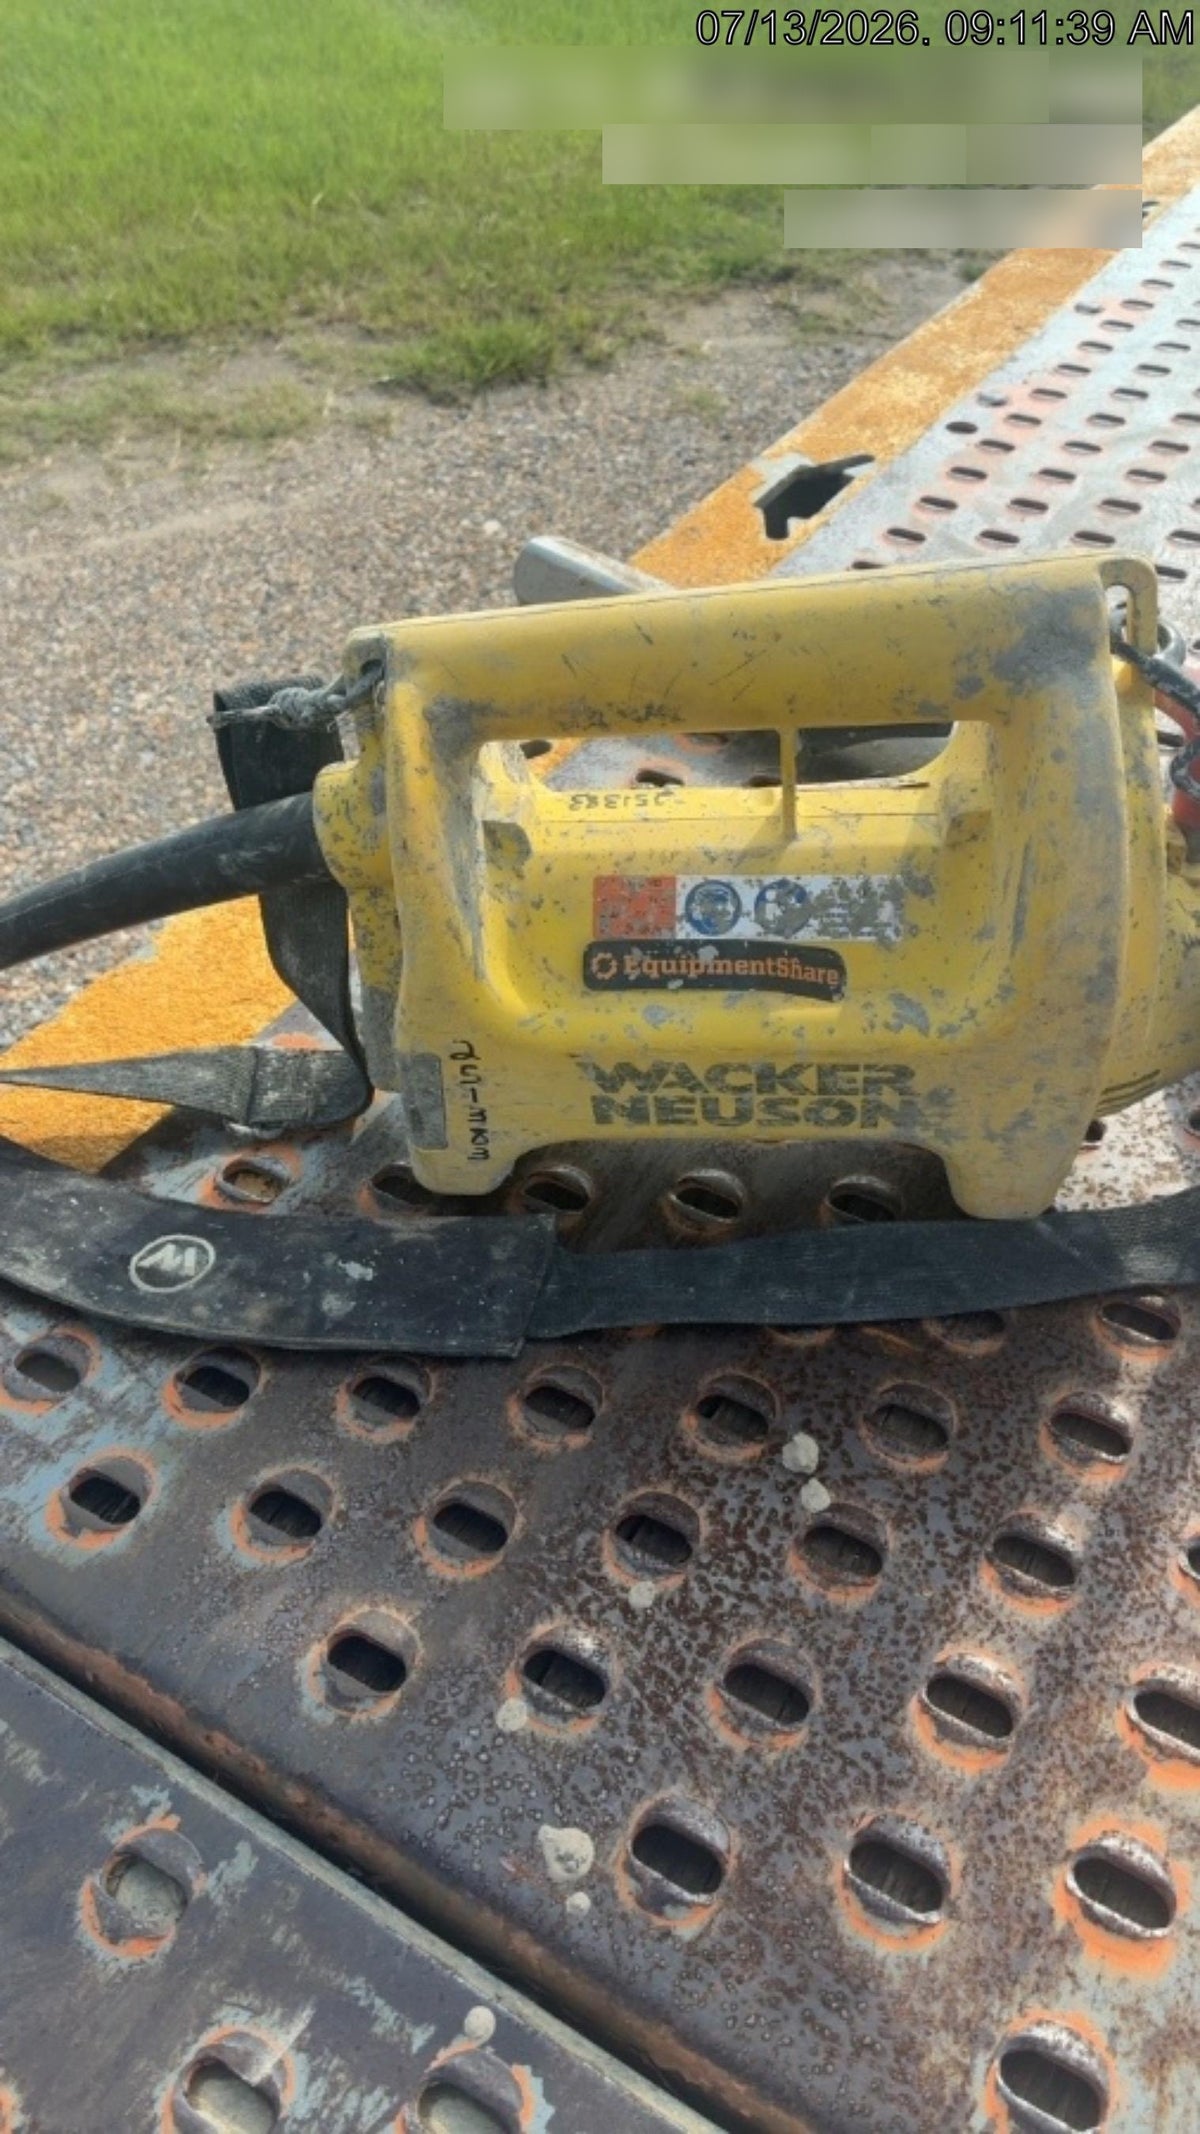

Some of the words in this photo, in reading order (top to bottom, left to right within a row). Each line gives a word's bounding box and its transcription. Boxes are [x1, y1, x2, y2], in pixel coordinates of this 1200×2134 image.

[623, 953, 840, 985] EquipmentShare
[575, 1061, 920, 1096] WACKER
[590, 1095, 924, 1128] NEUSON
